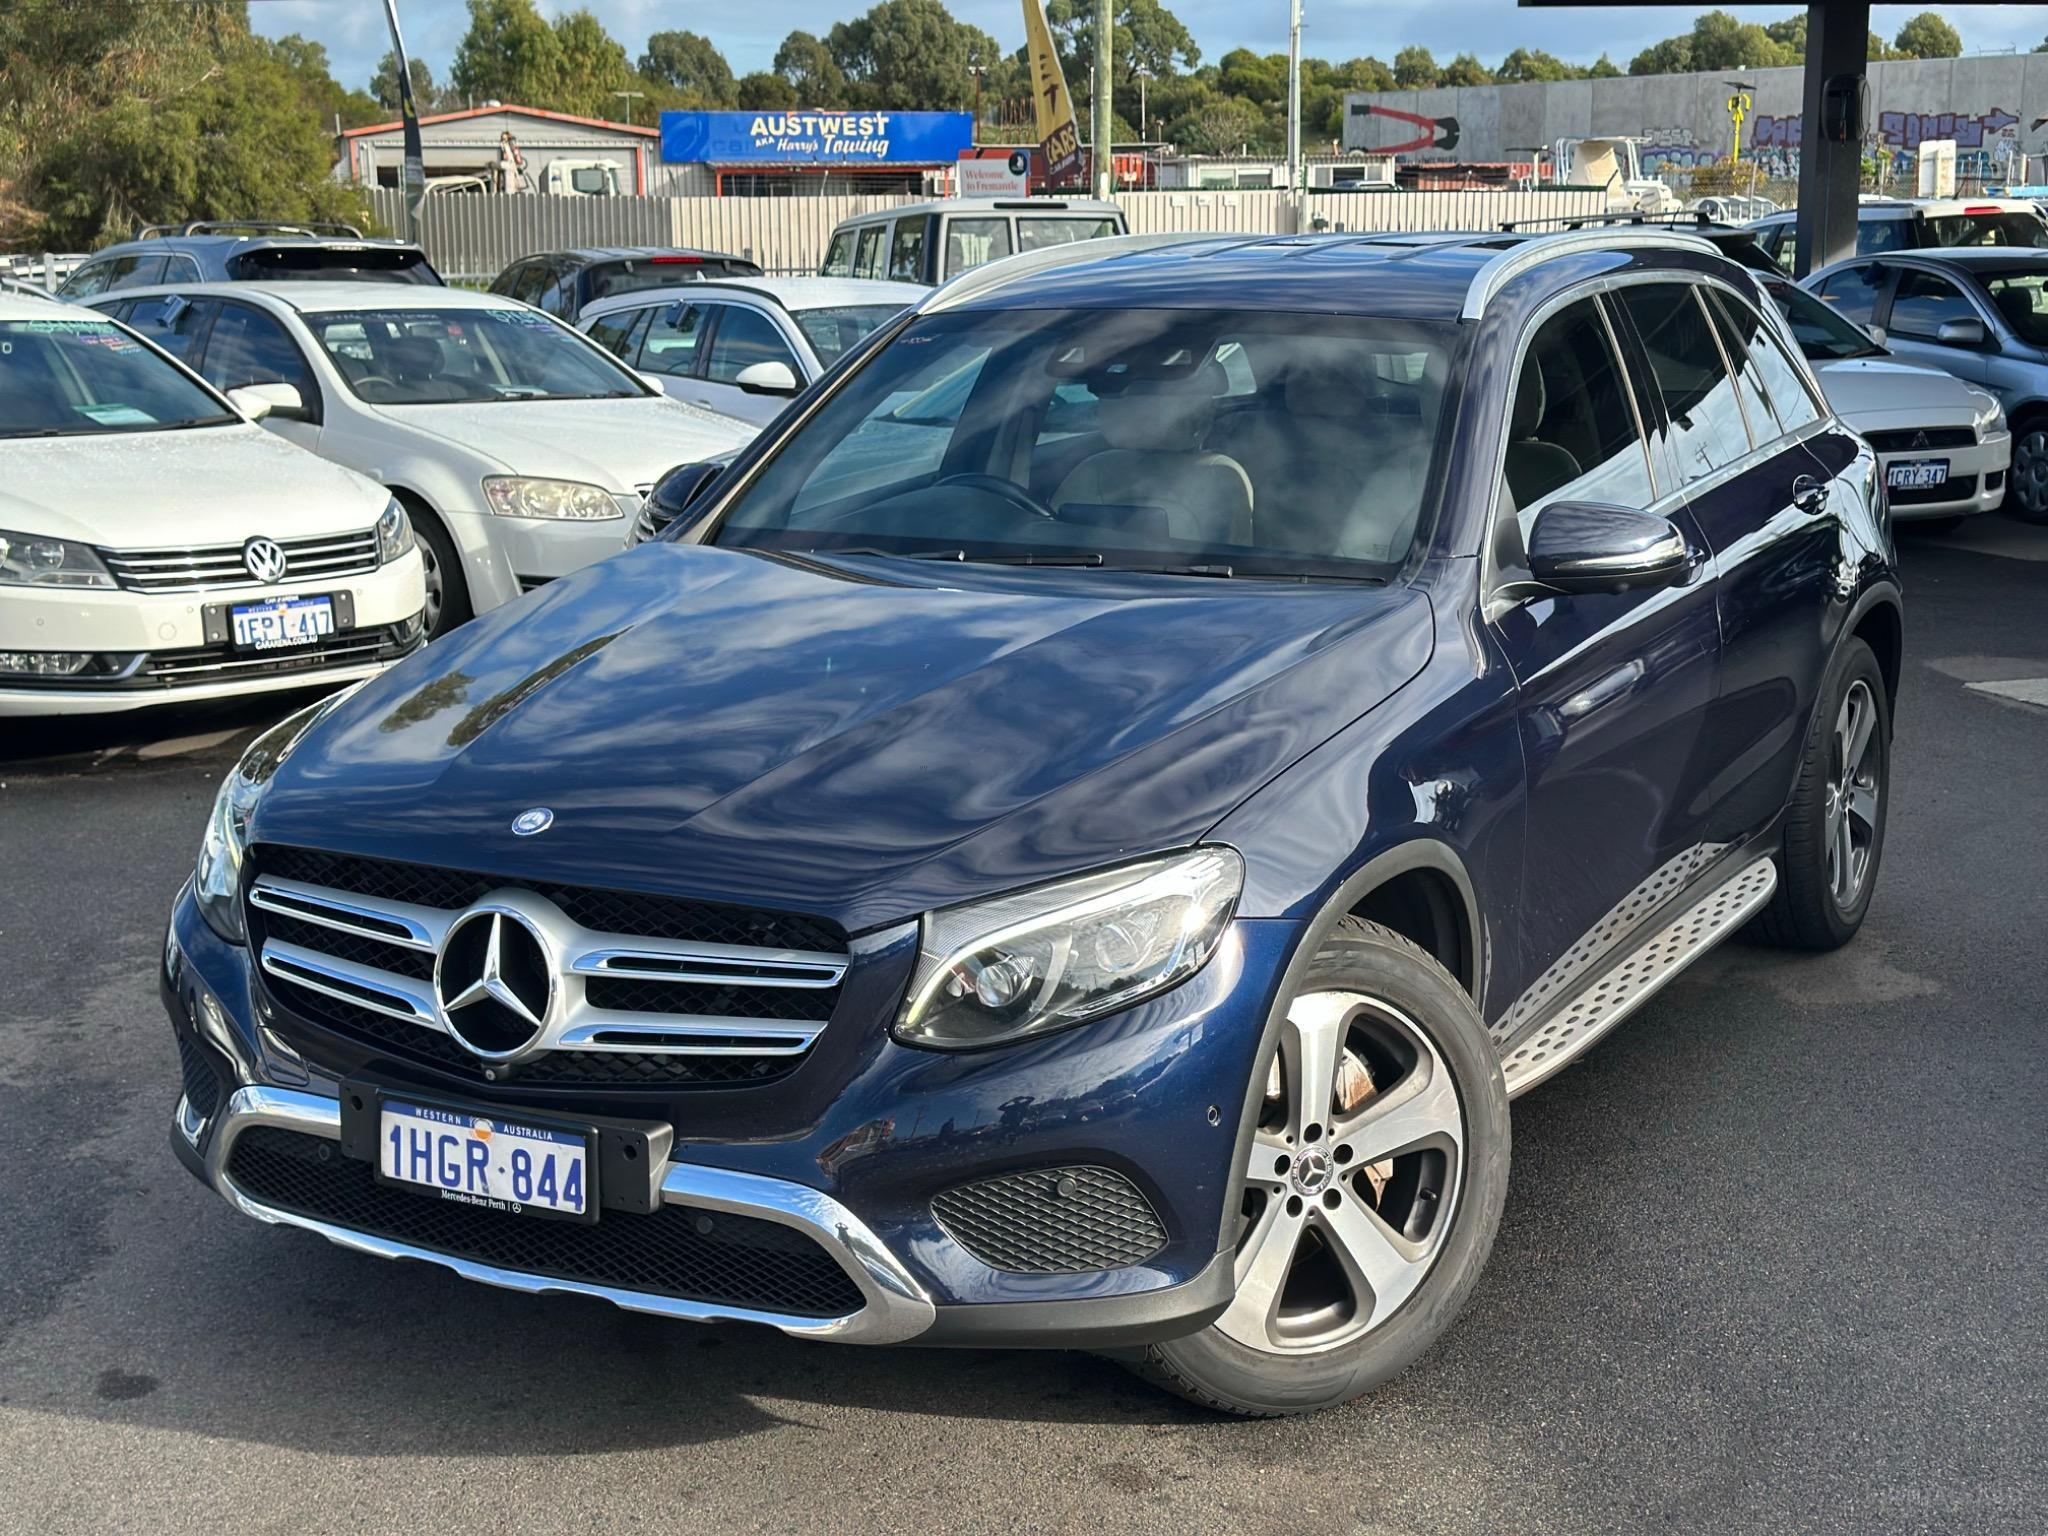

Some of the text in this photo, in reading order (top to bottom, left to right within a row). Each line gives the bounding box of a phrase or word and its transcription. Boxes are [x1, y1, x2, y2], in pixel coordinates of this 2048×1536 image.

[750, 112, 889, 136] AUSTWEST
[755, 133, 889, 157] AKA Harry's Towing
[965, 169, 1005, 179] Welcome
[966, 181, 1019, 191] to Fremantle
[415, 1108, 553, 1141] WESTERN AUSTRALIA
[441, 1189, 506, 1211] Mercedes-Benz Perth
